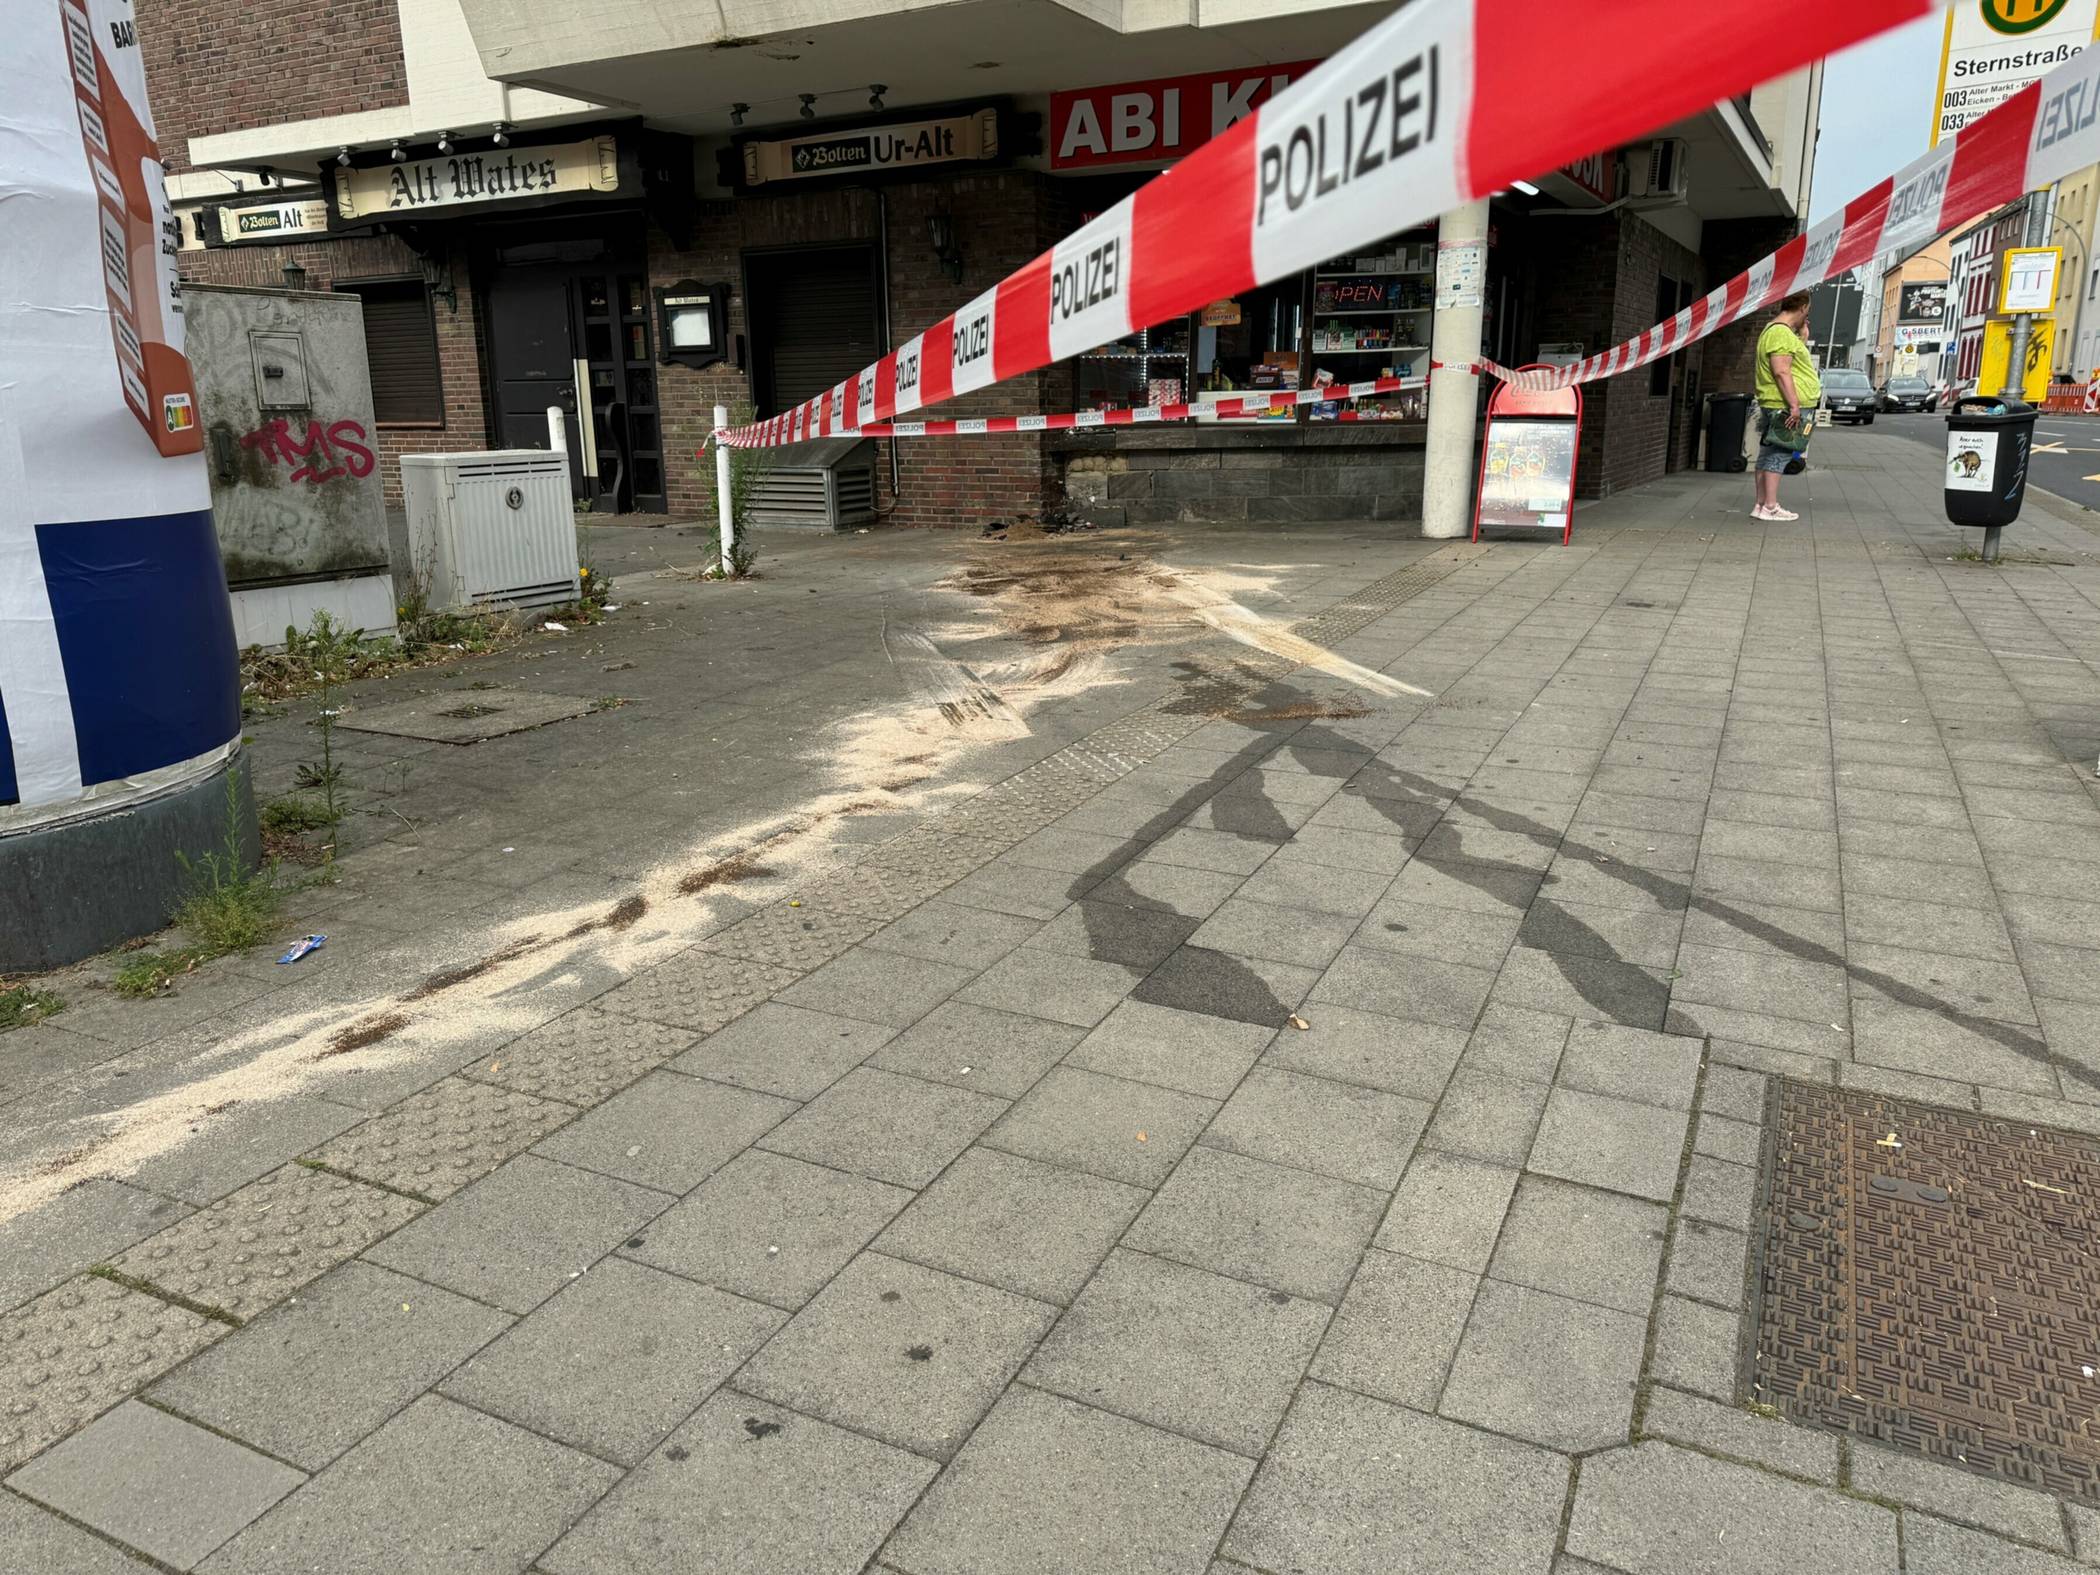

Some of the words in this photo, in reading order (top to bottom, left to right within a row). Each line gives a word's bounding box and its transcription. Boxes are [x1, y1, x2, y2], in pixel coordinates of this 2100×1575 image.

[1953, 44, 2083, 77] Sternstraße
[1943, 90, 1967, 109] 003
[1969, 87, 1988, 97] Alter
[1990, 82, 2014, 93] Markt
[1967, 96, 1995, 106] Eicken
[1057, 87, 1180, 158] ABI
[1256, 43, 1440, 227] POLIZEI
[1941, 113, 1965, 131] 033
[812, 143, 867, 165] Bolten
[873, 125, 954, 163] Ur-Alt
[390, 164, 440, 208] Alt
[250, 215, 279, 229] Bolten
[283, 207, 304, 228] Alt
[1050, 236, 1121, 326] POLIZEI
[952, 312, 989, 369] POLIZEI
[895, 353, 919, 393] POLIZEI
